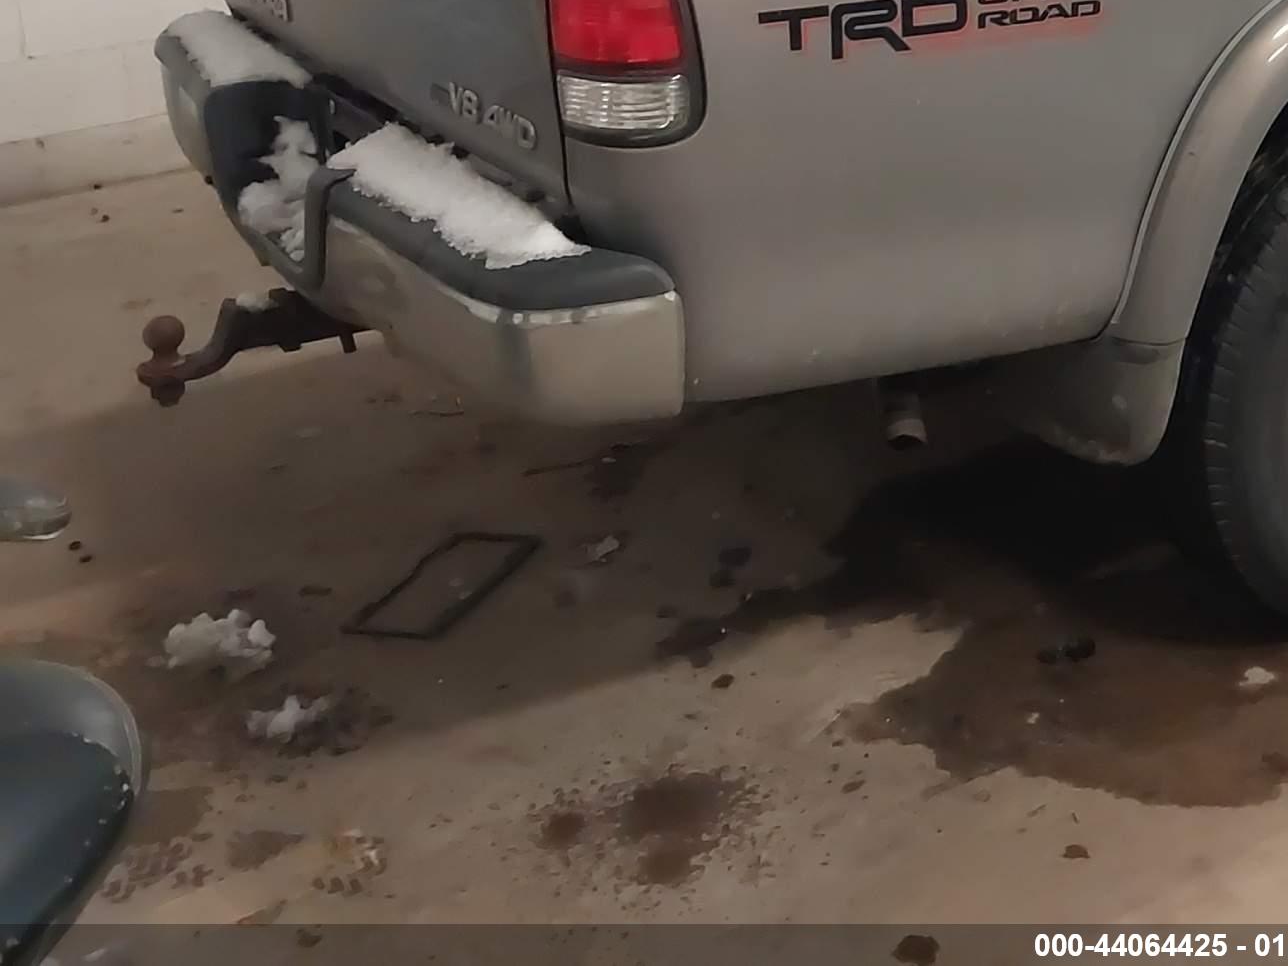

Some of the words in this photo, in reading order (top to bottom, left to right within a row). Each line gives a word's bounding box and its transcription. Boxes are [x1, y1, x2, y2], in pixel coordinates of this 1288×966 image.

[977, 0, 1101, 29] ROAD
[448, 81, 481, 123] V8
[483, 104, 537, 150] 4WD
